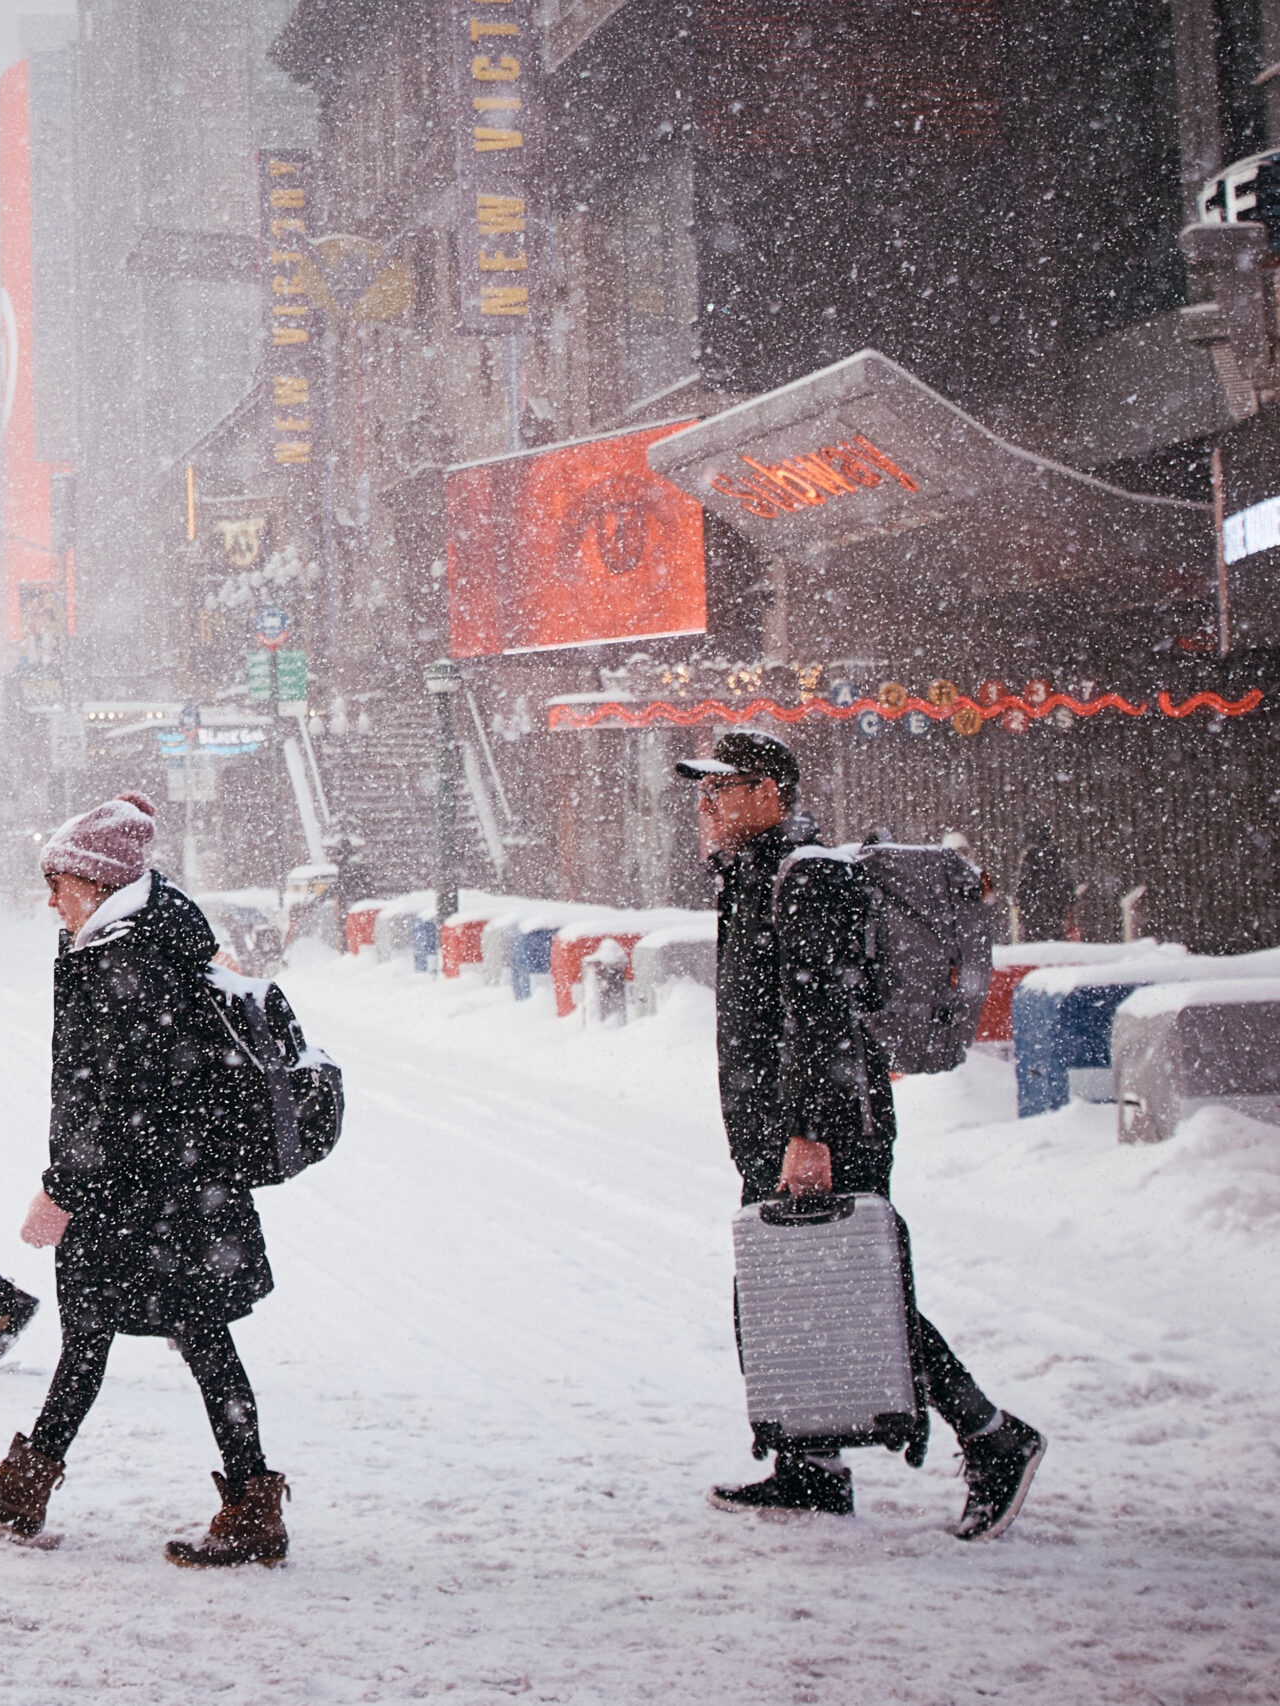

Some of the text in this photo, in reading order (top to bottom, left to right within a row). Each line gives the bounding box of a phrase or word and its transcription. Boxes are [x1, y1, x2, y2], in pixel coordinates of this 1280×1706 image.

[470, 0, 528, 315] NEW VICT
[270, 161, 312, 463] NEW VICTORY
[705, 435, 918, 518] Subway
